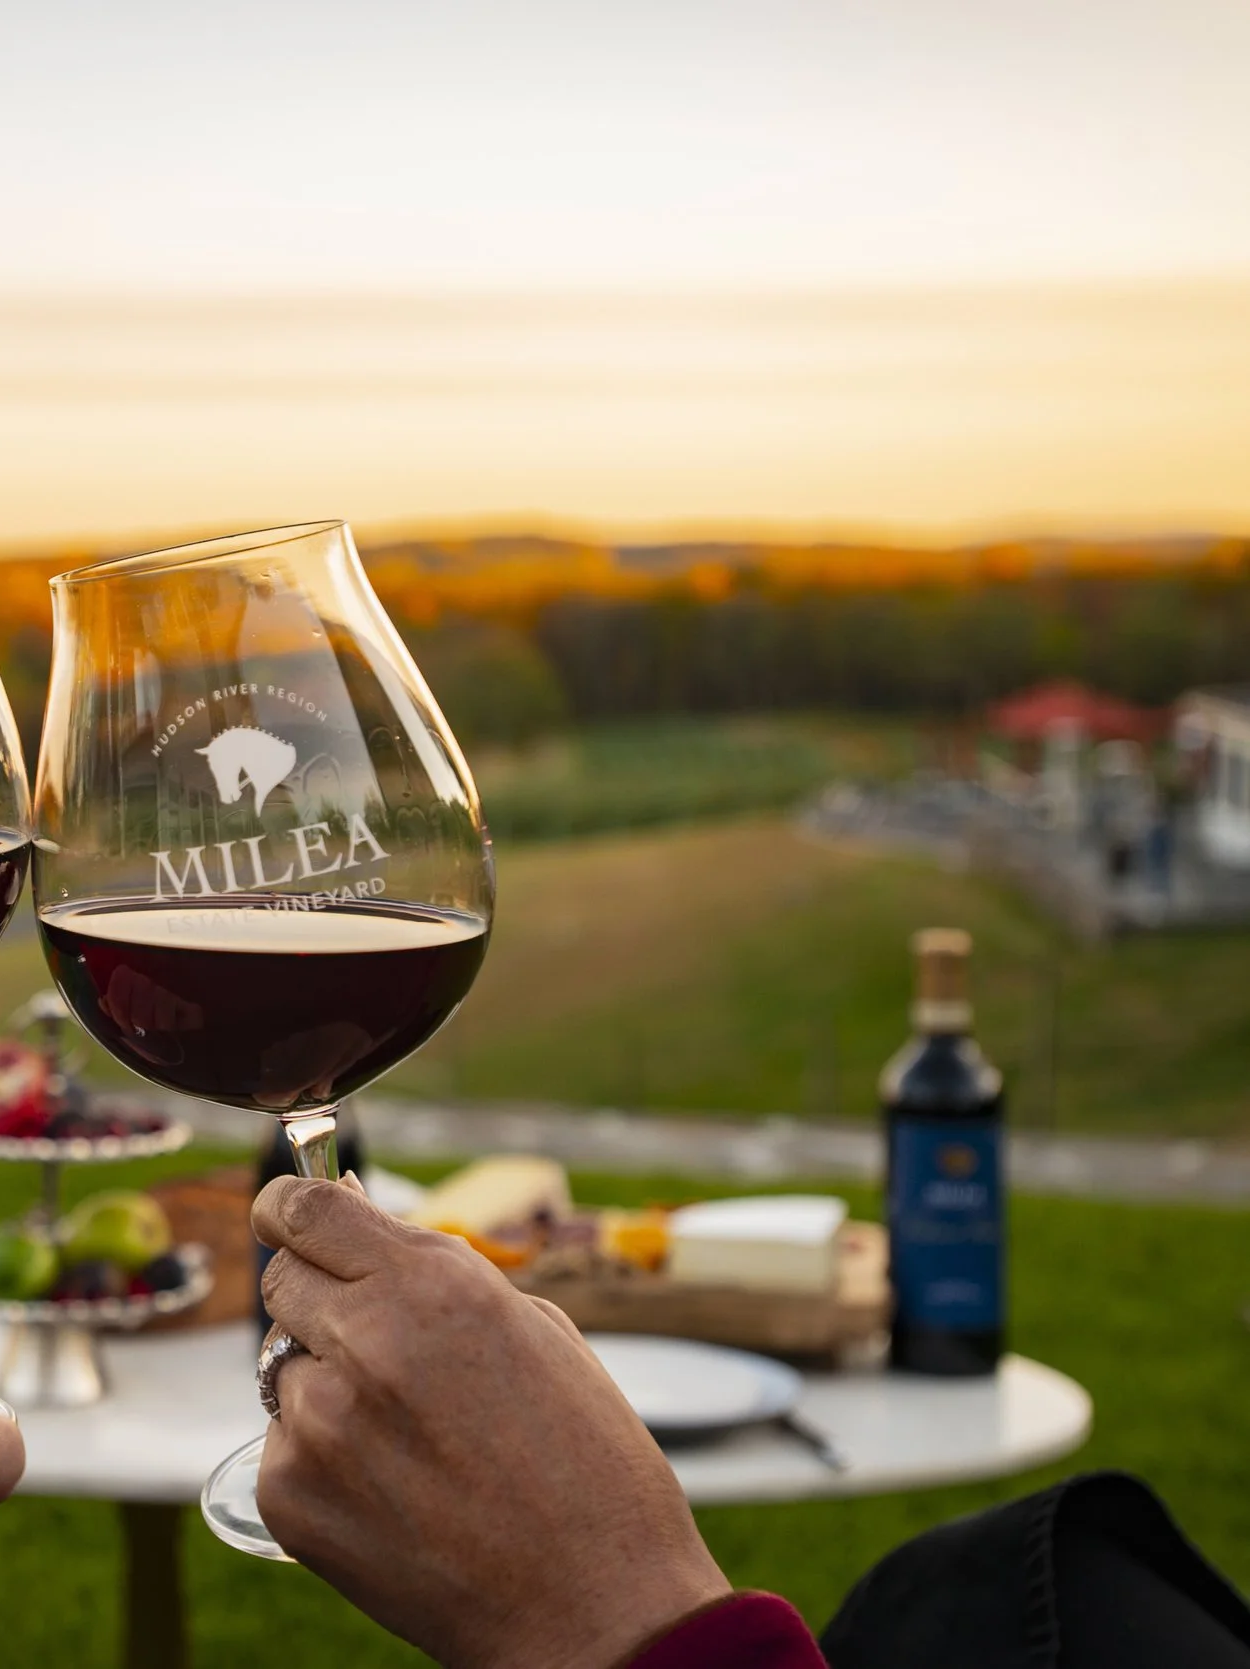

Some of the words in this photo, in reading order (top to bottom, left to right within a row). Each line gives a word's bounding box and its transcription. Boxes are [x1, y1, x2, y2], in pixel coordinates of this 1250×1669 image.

[151, 698, 207, 757] HUDSON
[213, 683, 259, 701] RIVER
[267, 685, 327, 722] REGION
[150, 813, 391, 902] MILEA
[167, 906, 255, 933] ESTATE
[264, 877, 386, 917] VINEYARD
